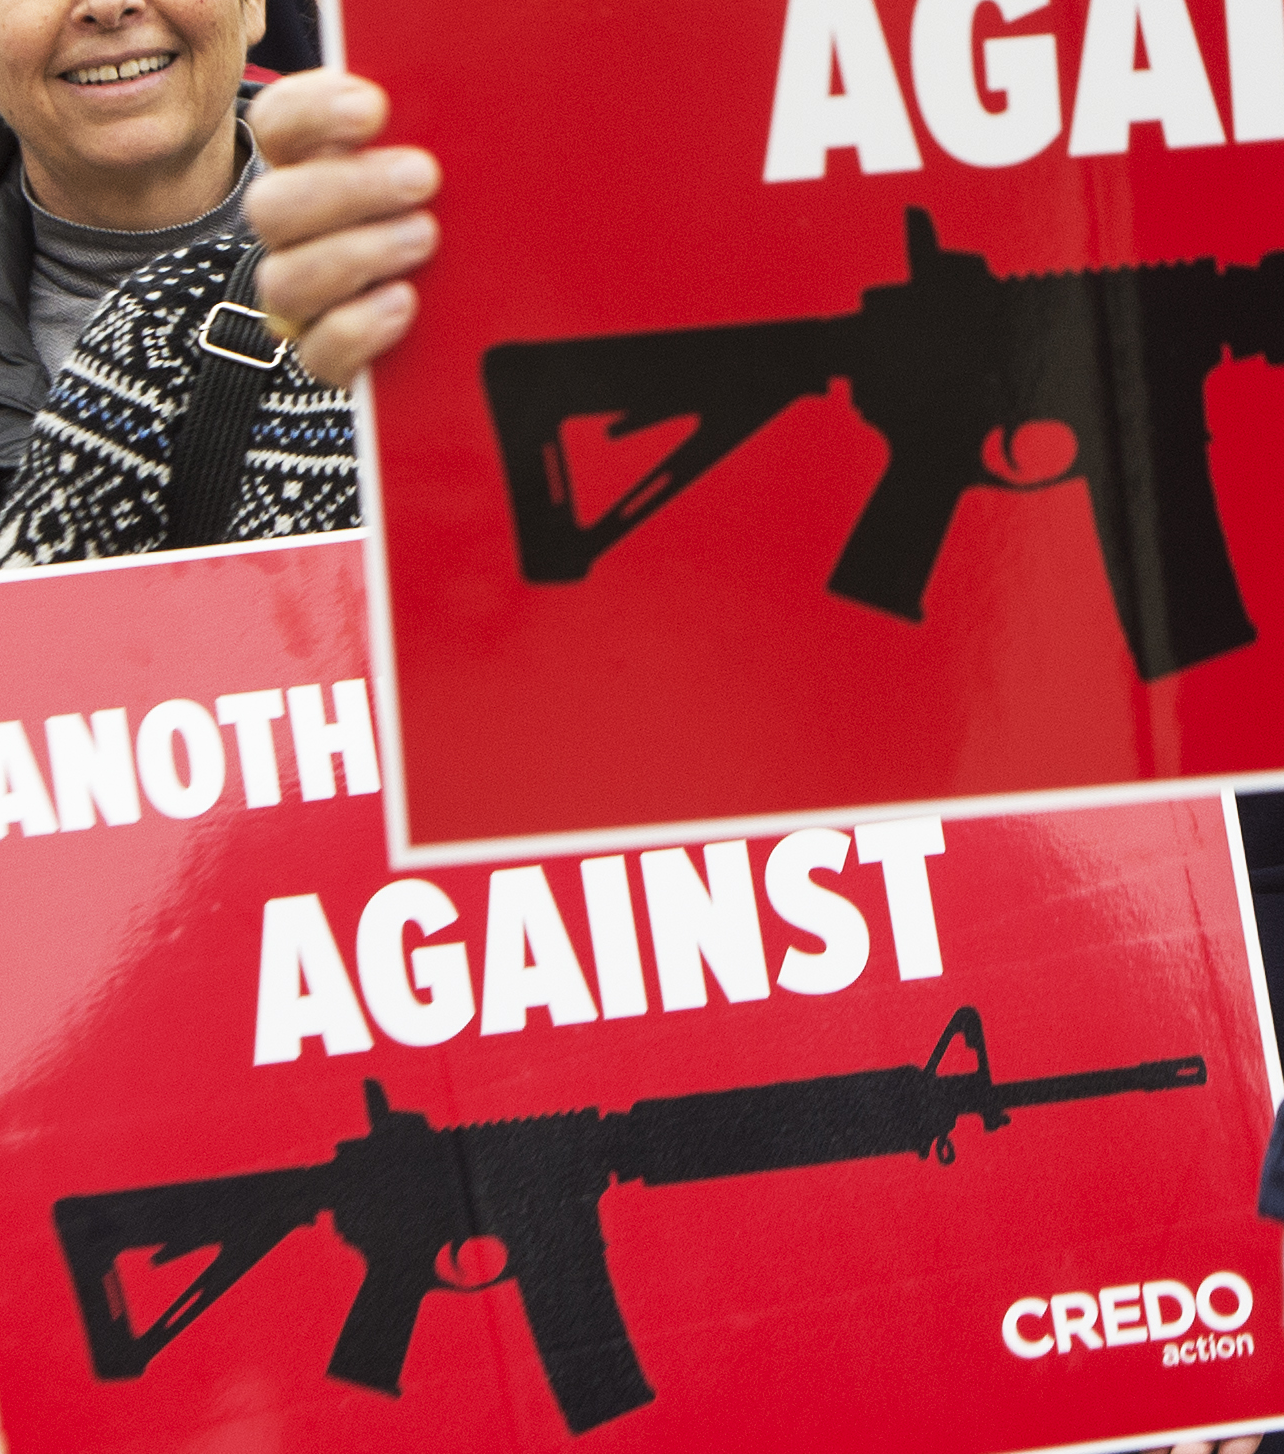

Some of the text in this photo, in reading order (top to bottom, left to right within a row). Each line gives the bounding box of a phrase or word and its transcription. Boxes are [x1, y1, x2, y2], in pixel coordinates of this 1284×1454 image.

[252, 816, 947, 1067] AGAINST
[1000, 1270, 1255, 1359] CREDO
[1162, 1332, 1256, 1368] action
